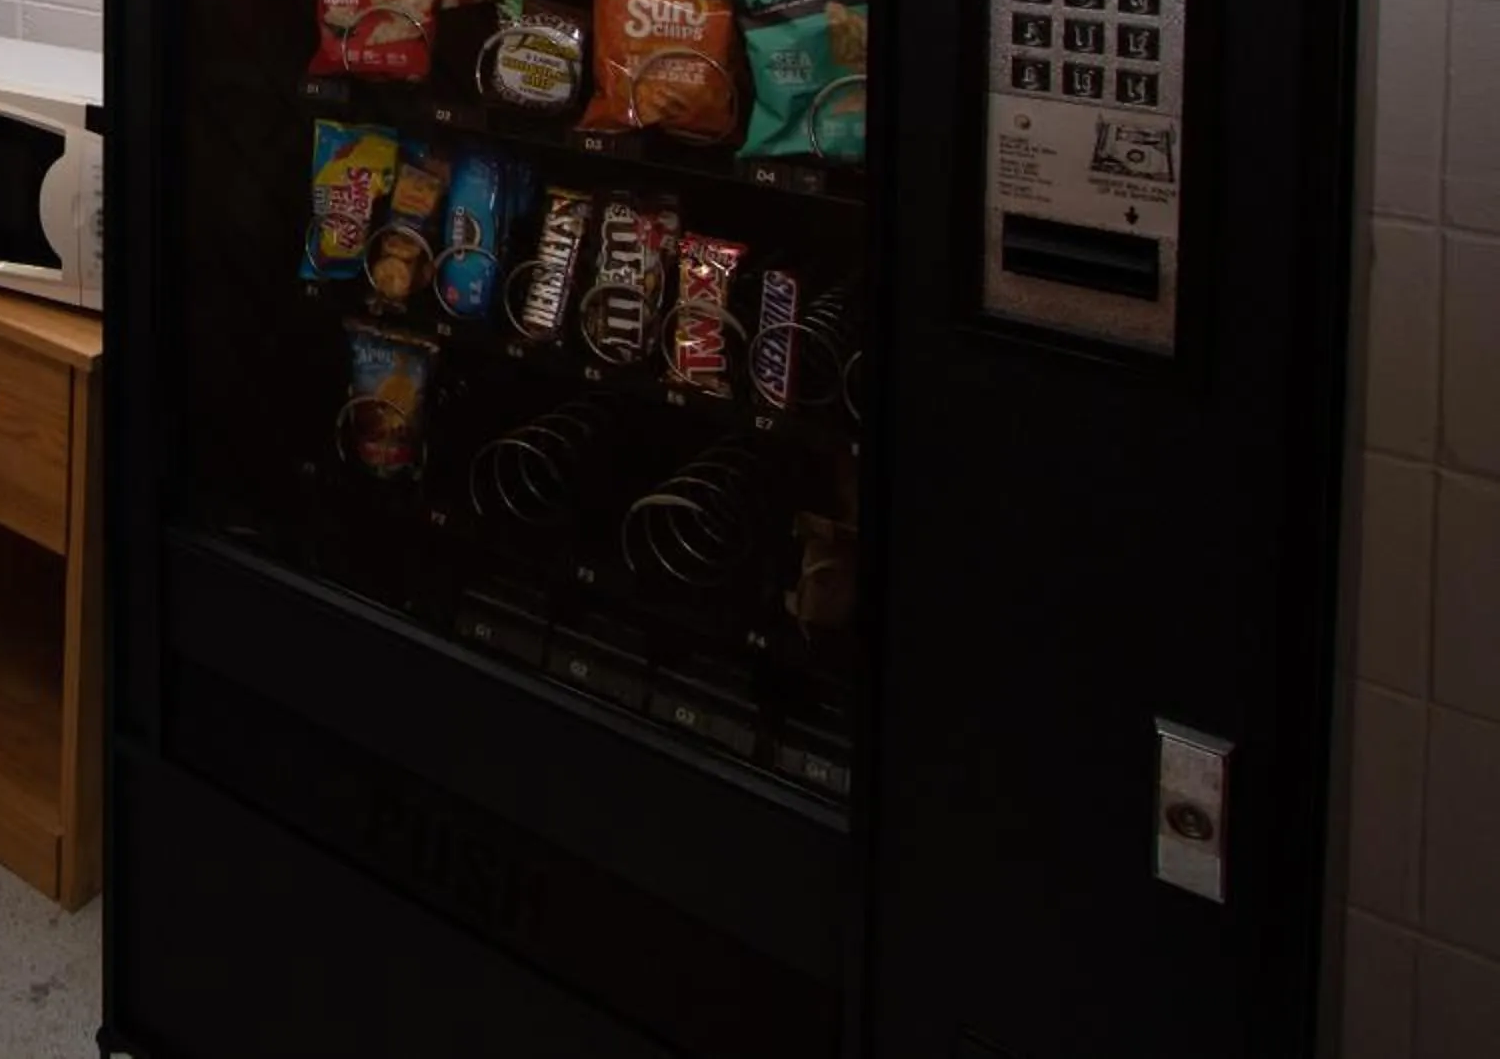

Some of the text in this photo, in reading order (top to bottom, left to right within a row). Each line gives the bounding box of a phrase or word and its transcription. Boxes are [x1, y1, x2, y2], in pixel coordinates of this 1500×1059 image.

[756, 169, 775, 181] D4
[677, 266, 728, 380] TWIX
[755, 416, 773, 430] E7
